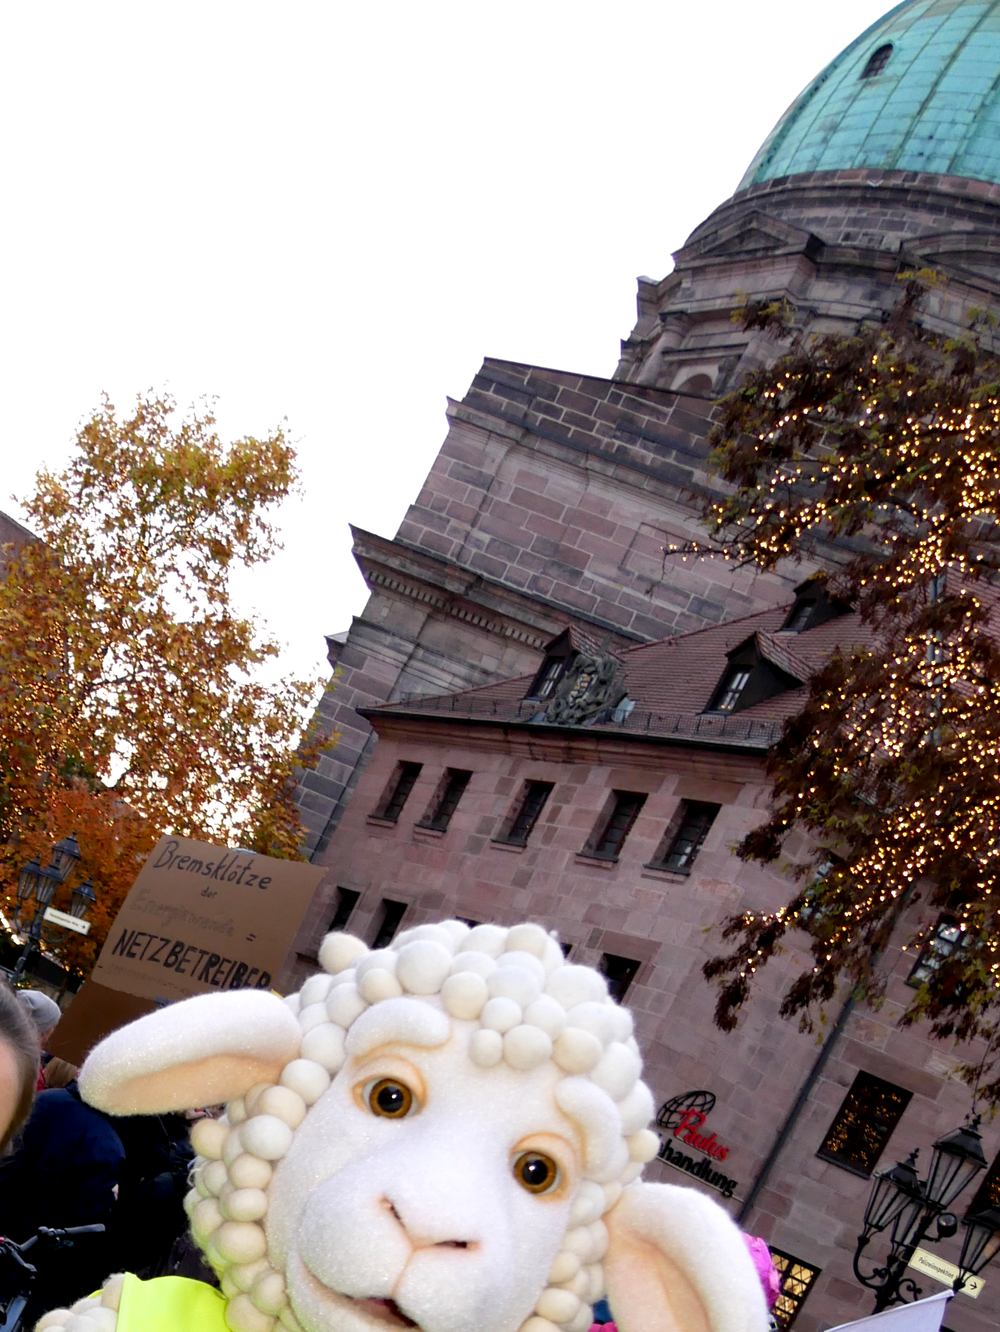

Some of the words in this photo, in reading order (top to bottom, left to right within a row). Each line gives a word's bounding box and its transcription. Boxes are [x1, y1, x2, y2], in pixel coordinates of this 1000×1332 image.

[153, 840, 273, 890] Bremsklötze
[201, 885, 218, 899] der
[111, 928, 272, 989] NETZBETREIBER
[674, 1107, 730, 1162] Paulus
[658, 1138, 738, 1198] handlung
